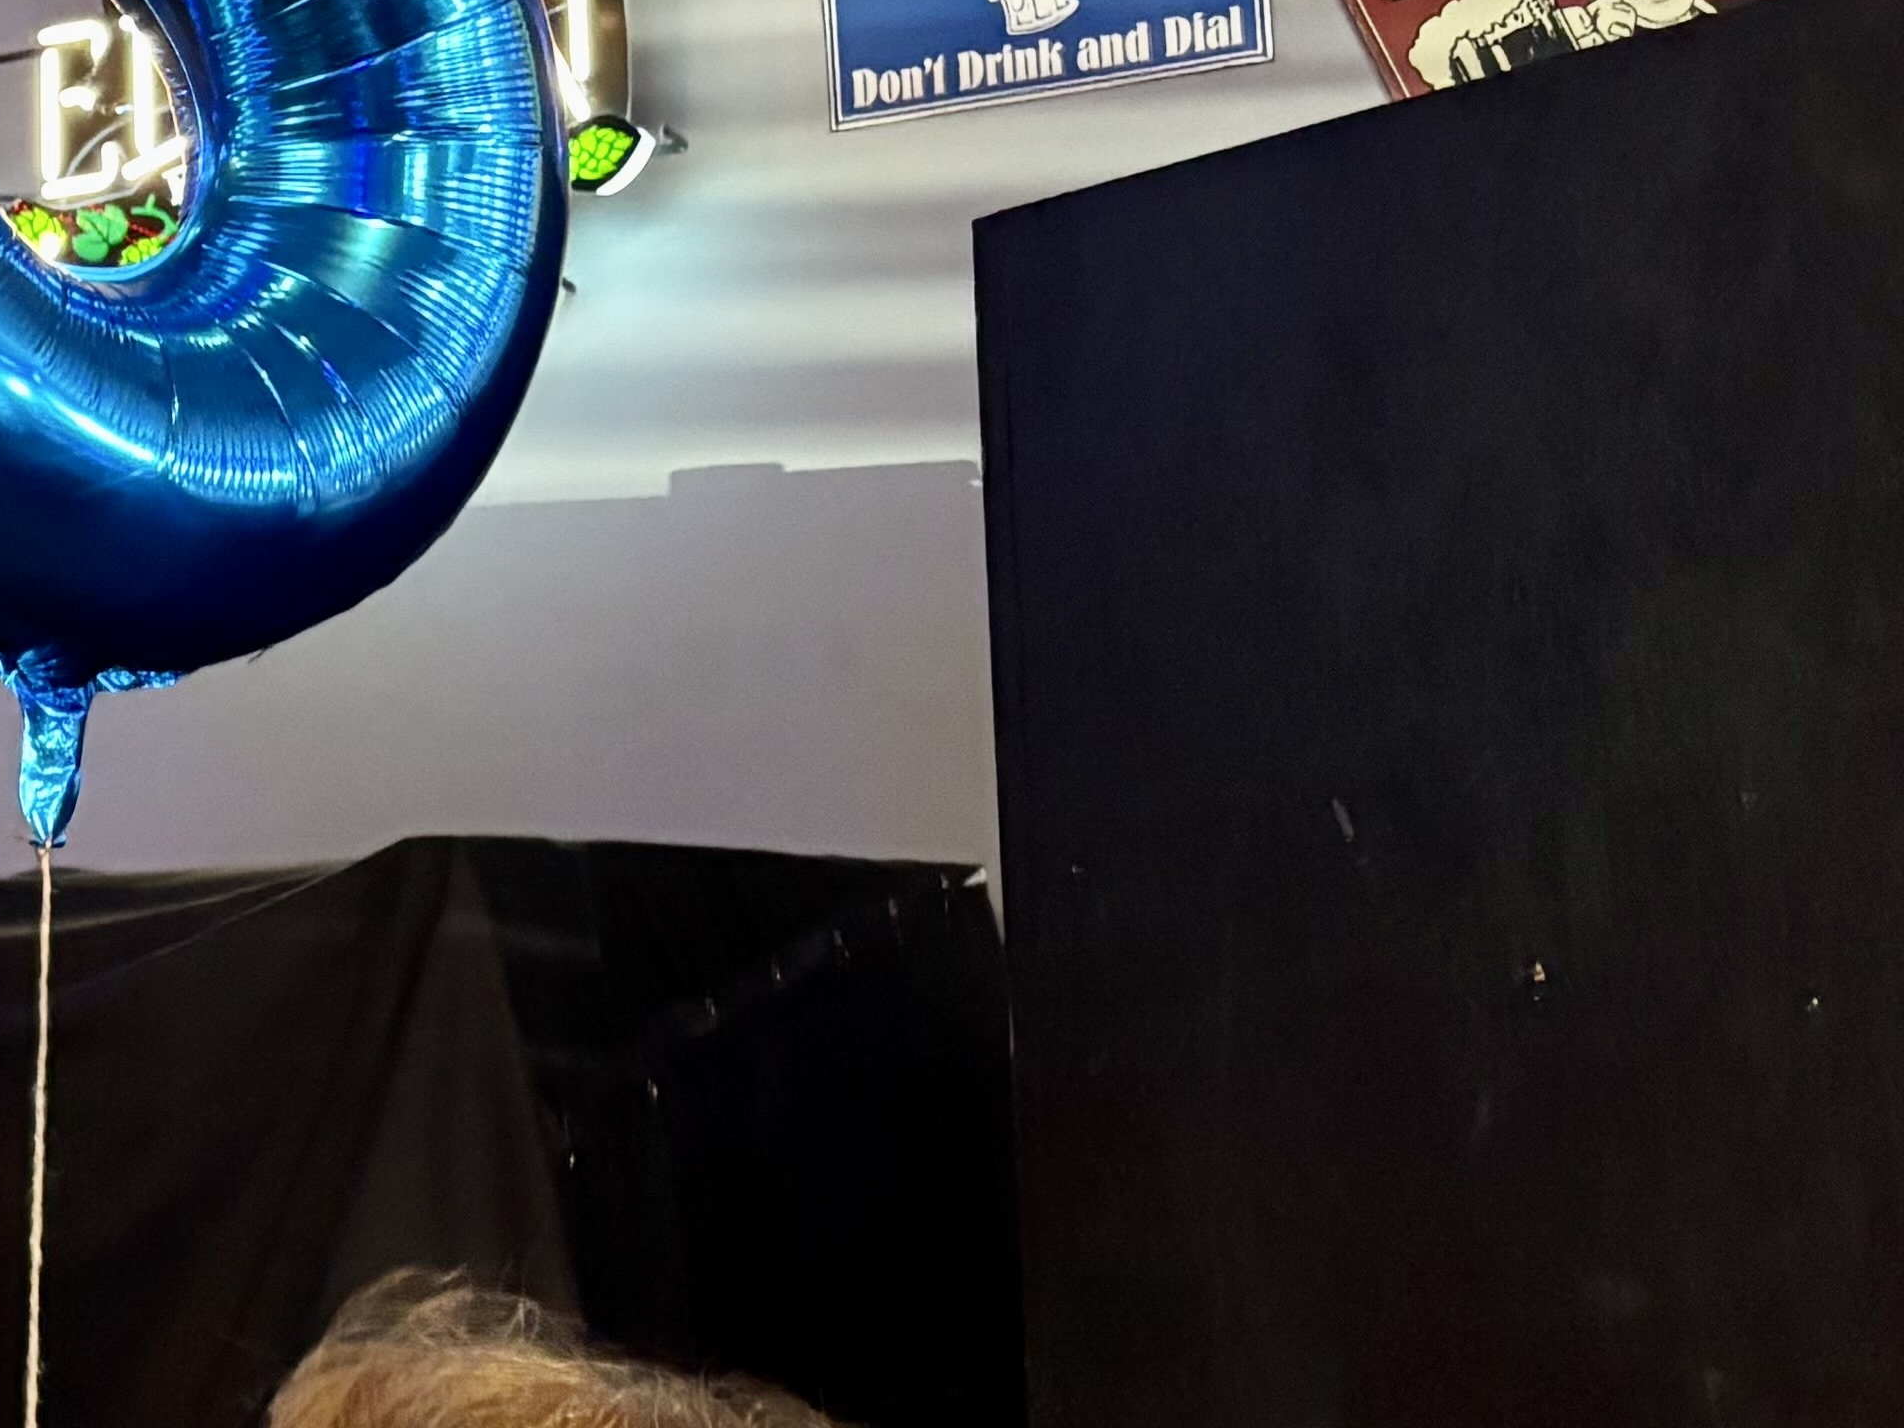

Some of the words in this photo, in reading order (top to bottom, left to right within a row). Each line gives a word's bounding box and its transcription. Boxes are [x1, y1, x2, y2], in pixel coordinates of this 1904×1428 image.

[852, 55, 946, 109] Don't
[957, 38, 1064, 92] Drink
[1077, 22, 1151, 71] and
[1163, 5, 1244, 58] Dial
